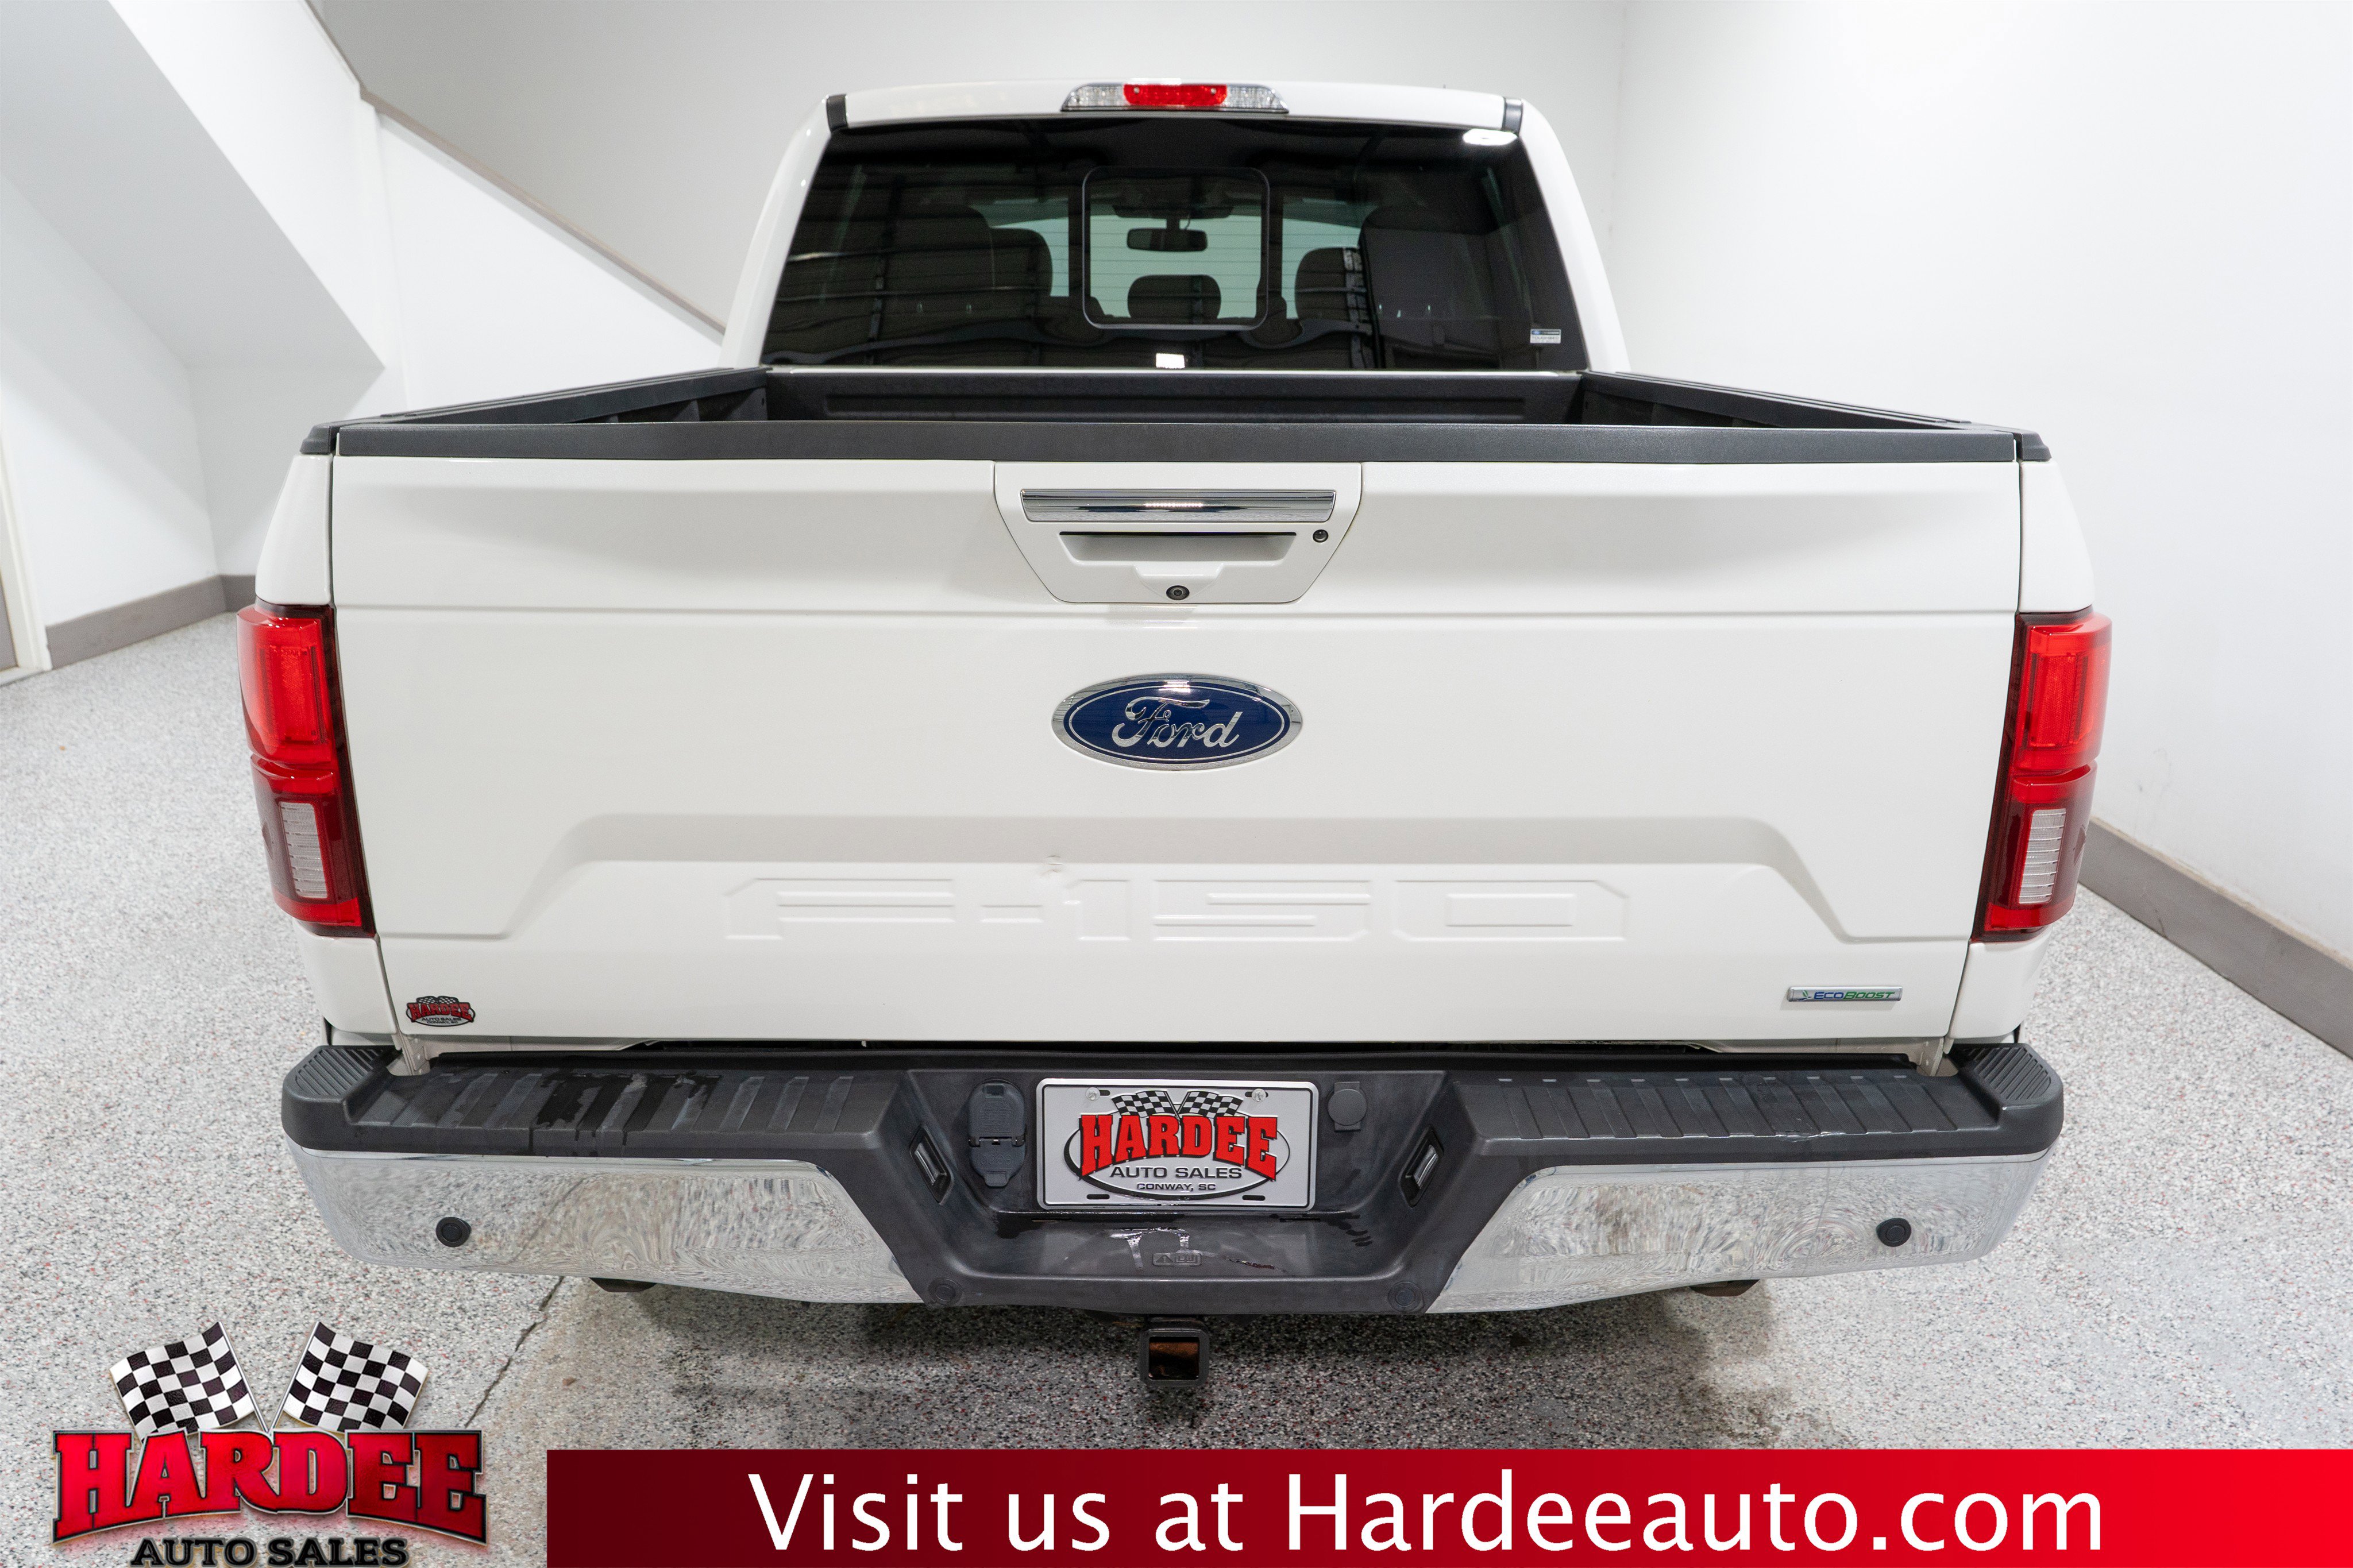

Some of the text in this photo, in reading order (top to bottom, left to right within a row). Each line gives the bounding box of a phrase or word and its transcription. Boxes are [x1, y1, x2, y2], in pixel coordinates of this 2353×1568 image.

[1112, 696, 1243, 748] Ford
[725, 876, 1629, 941] F-150
[407, 1002, 473, 1022] HARDEE
[1079, 1114, 1279, 1181] HARDEE
[1110, 1166, 1243, 1179] AUTO SALES
[1136, 1183, 1194, 1192] CONWAY,
